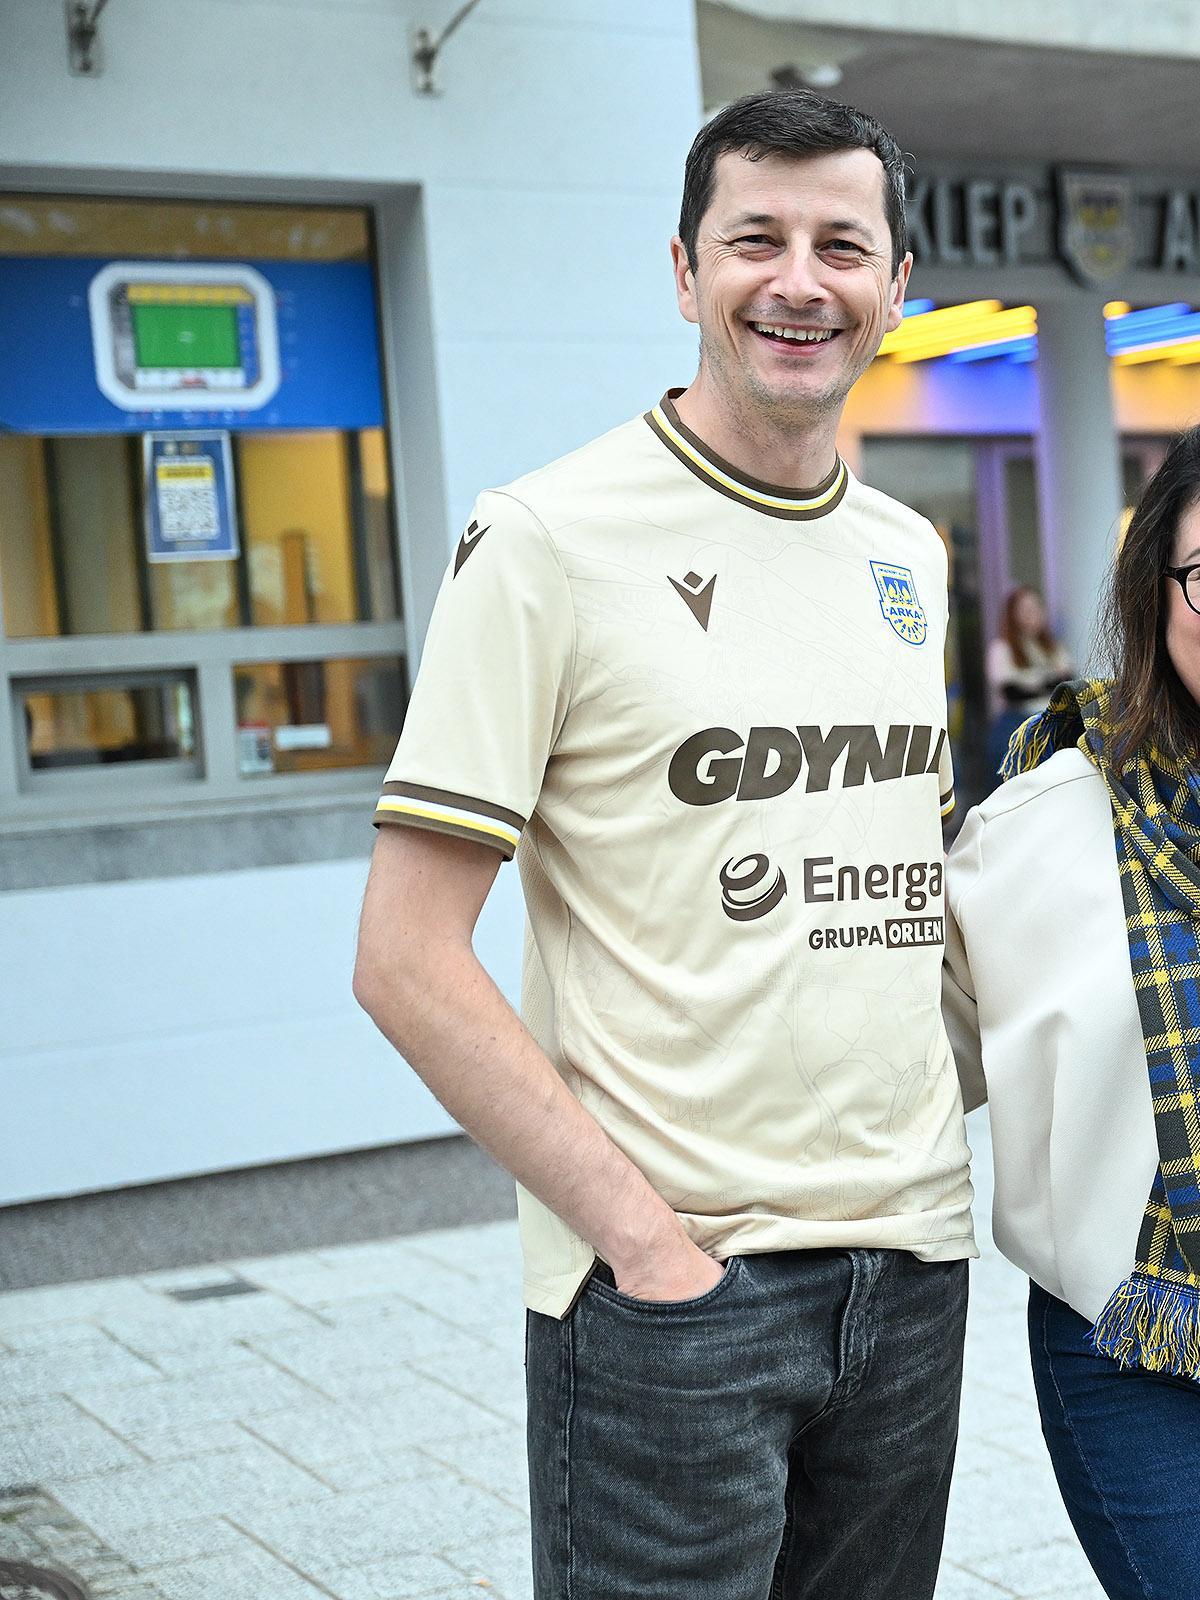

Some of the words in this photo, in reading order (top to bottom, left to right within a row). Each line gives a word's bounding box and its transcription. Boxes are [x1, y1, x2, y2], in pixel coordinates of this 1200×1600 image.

[904, 181, 1036, 264] KLEP
[889, 606, 921, 619] ARKA
[668, 725, 946, 807] GDYNI
[803, 856, 942, 912] Energa
[808, 925, 884, 950] GRUPA
[887, 919, 942, 944] ORLEN
